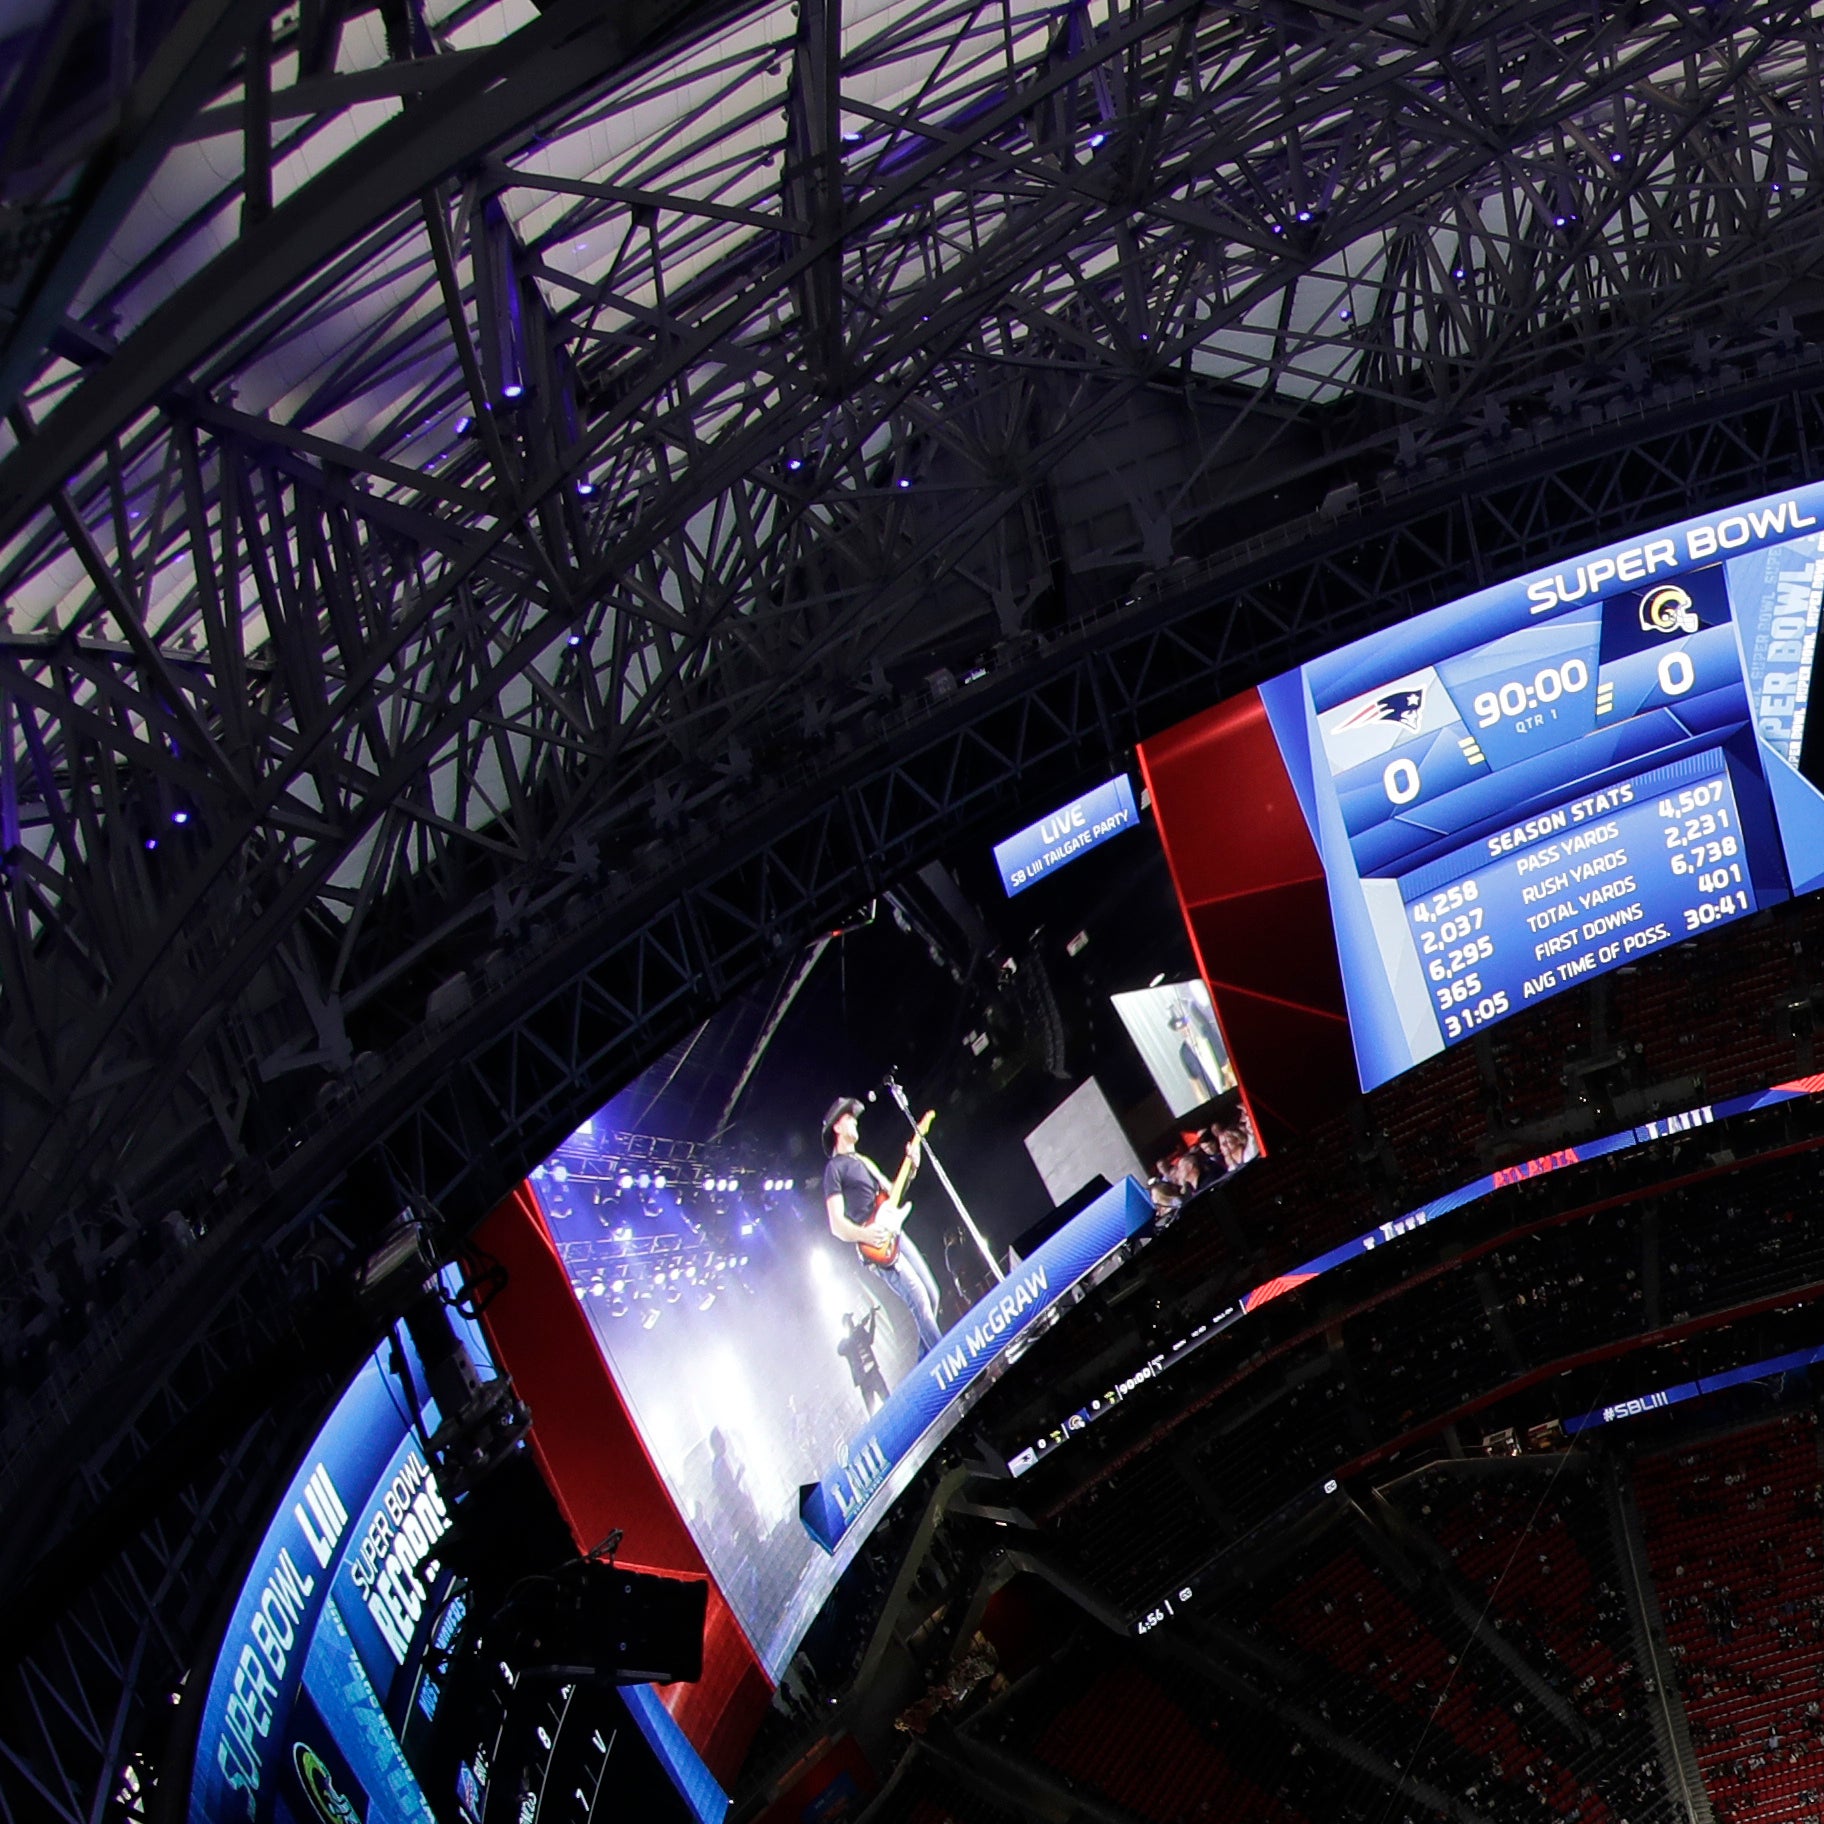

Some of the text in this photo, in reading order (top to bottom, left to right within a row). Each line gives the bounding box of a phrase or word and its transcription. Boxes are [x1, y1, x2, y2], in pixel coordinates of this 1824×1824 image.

[1527, 538, 1678, 615] SUPER
[1687, 500, 1816, 560] BOWL
[1474, 658, 1589, 729] 90:00
[1657, 651, 1695, 696] 0
[1515, 714, 1545, 734] QTR
[1041, 804, 1086, 844] LIVE
[1383, 758, 1421, 805] 0
[1488, 784, 1634, 857] SEASON STATS
[1042, 809, 1128, 865] TAILGATE PARTY
[1413, 780, 1724, 924] 4,258 PASS YARDS 4,507
[1420, 809, 1729, 955] 2,037 RUSH YARDS 2,231
[1428, 837, 1738, 982] 6,295 TOTAL YARDS 6,738
[1436, 864, 1742, 1010] 365 FIRST DOWNS 401
[1444, 890, 1749, 1039] 31:05 AVG TIME OF POSS. 30:41
[930, 1265, 1048, 1390] TIM McGRAW
[1603, 1391, 1668, 1422] #SBLIII
[218, 1462, 348, 1822] SUPER BOWL LIII
